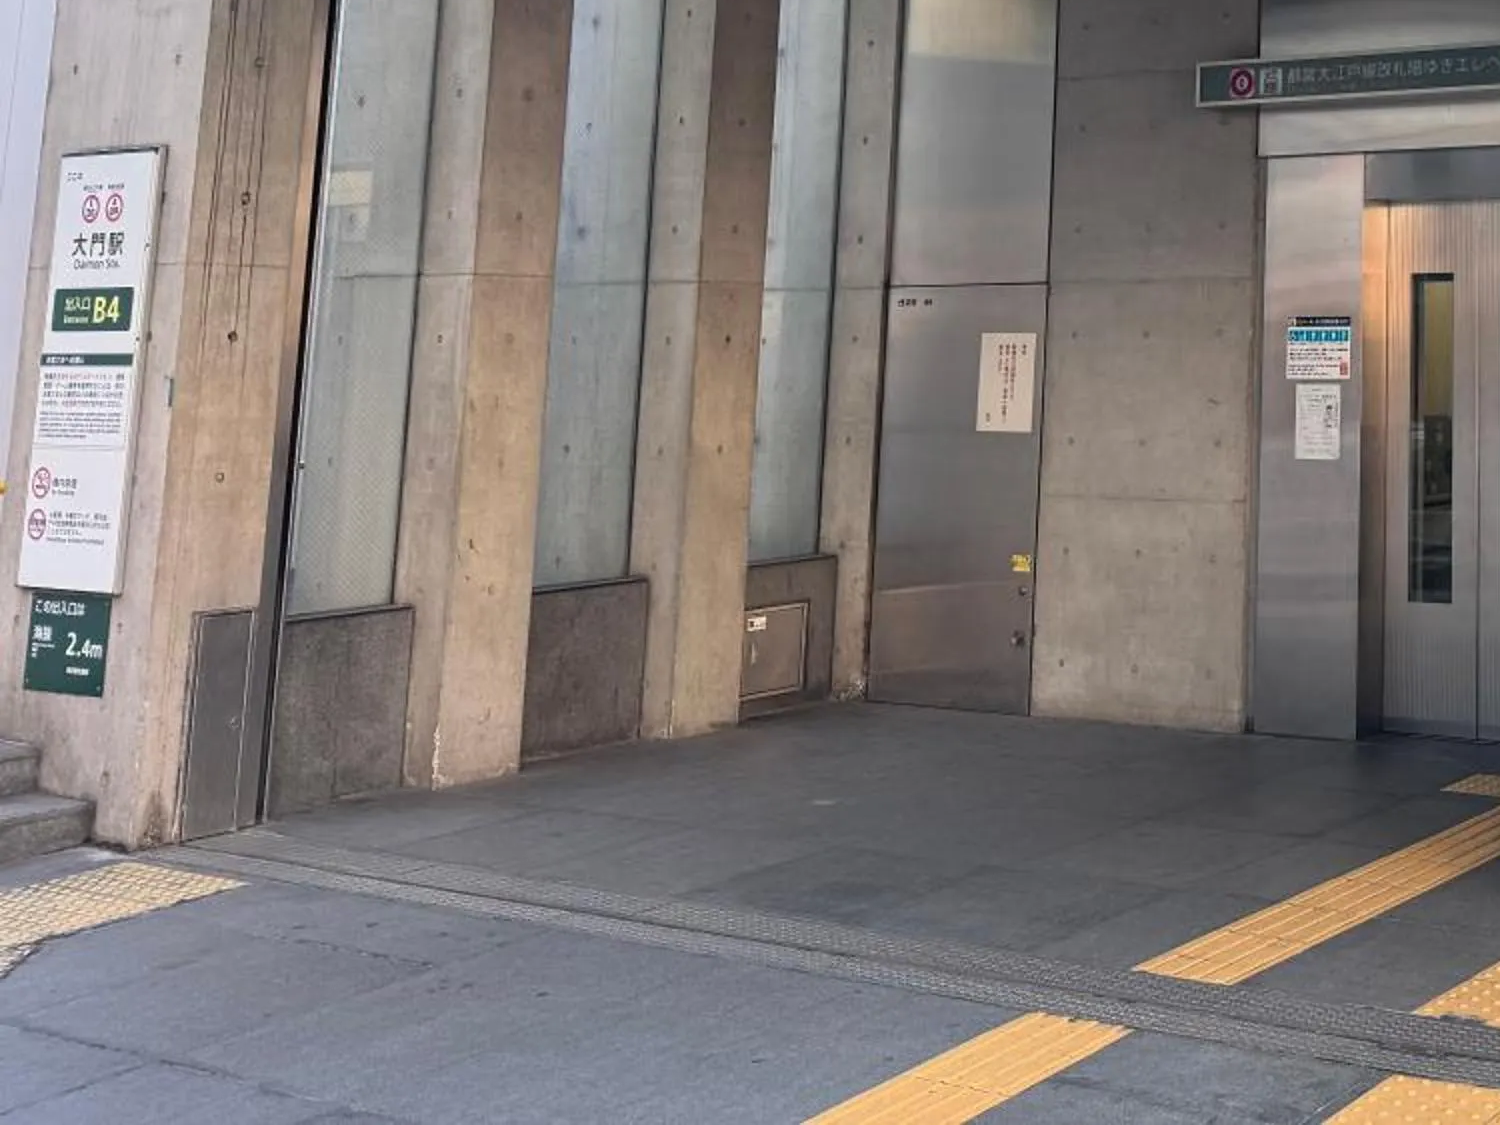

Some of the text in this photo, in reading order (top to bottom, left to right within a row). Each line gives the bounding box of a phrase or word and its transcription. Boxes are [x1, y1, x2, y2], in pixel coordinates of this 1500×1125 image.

[72, 232, 125, 257] 大門駅
[92, 295, 121, 324] B4
[35, 600, 86, 616] この出入口は
[65, 632, 103, 659] 2.4m
